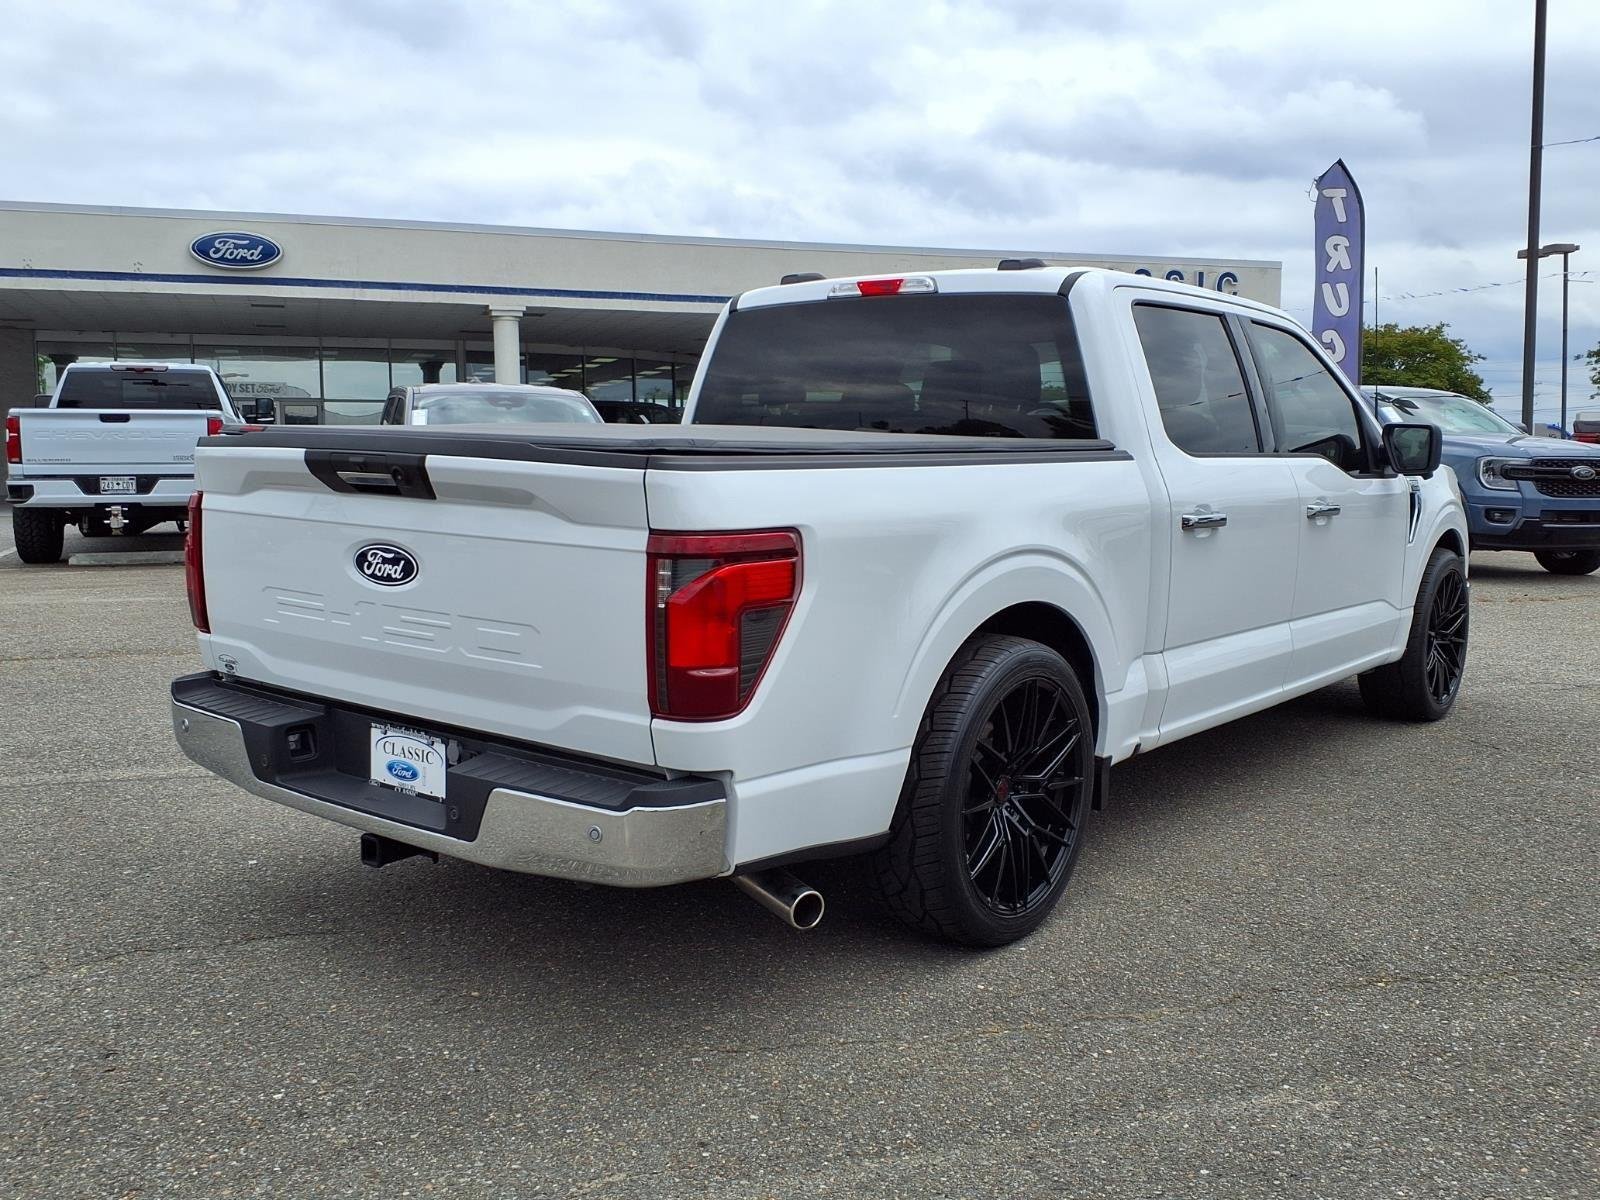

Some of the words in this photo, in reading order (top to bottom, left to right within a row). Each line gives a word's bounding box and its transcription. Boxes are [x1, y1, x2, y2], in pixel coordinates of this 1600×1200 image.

[209, 238, 264, 260] Ford
[239, 384, 256, 394] SET
[363, 549, 405, 579] Ford
[262, 585, 543, 669] F-150
[383, 740, 435, 765] CLASSIC
[392, 763, 413, 778] Ford
